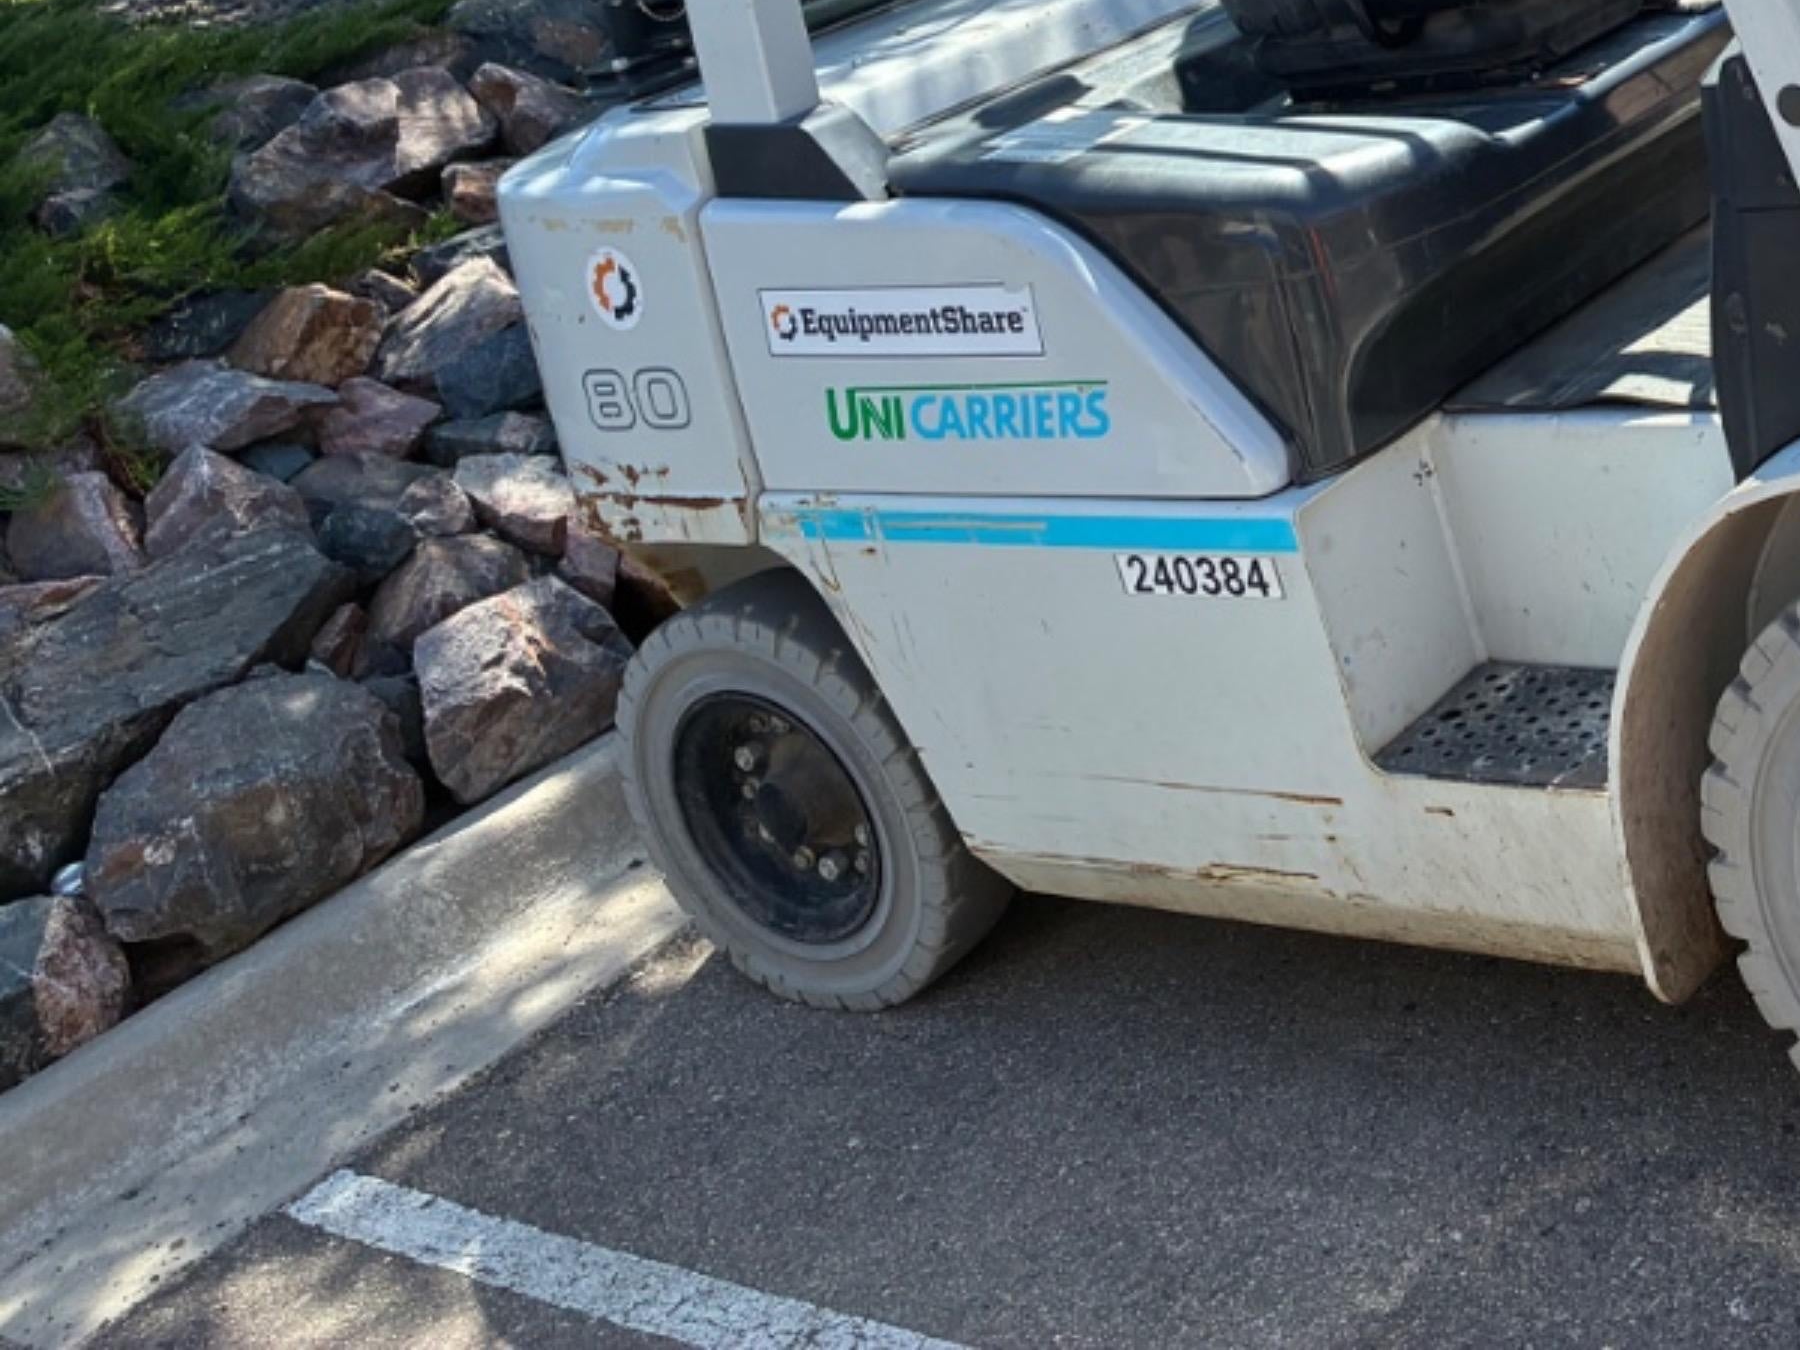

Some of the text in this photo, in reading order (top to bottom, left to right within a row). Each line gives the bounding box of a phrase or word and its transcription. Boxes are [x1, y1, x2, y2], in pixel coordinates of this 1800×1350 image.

[800, 306, 1024, 342] EquipmentShare
[582, 366, 692, 431] 80
[1126, 554, 1270, 598] 240384
